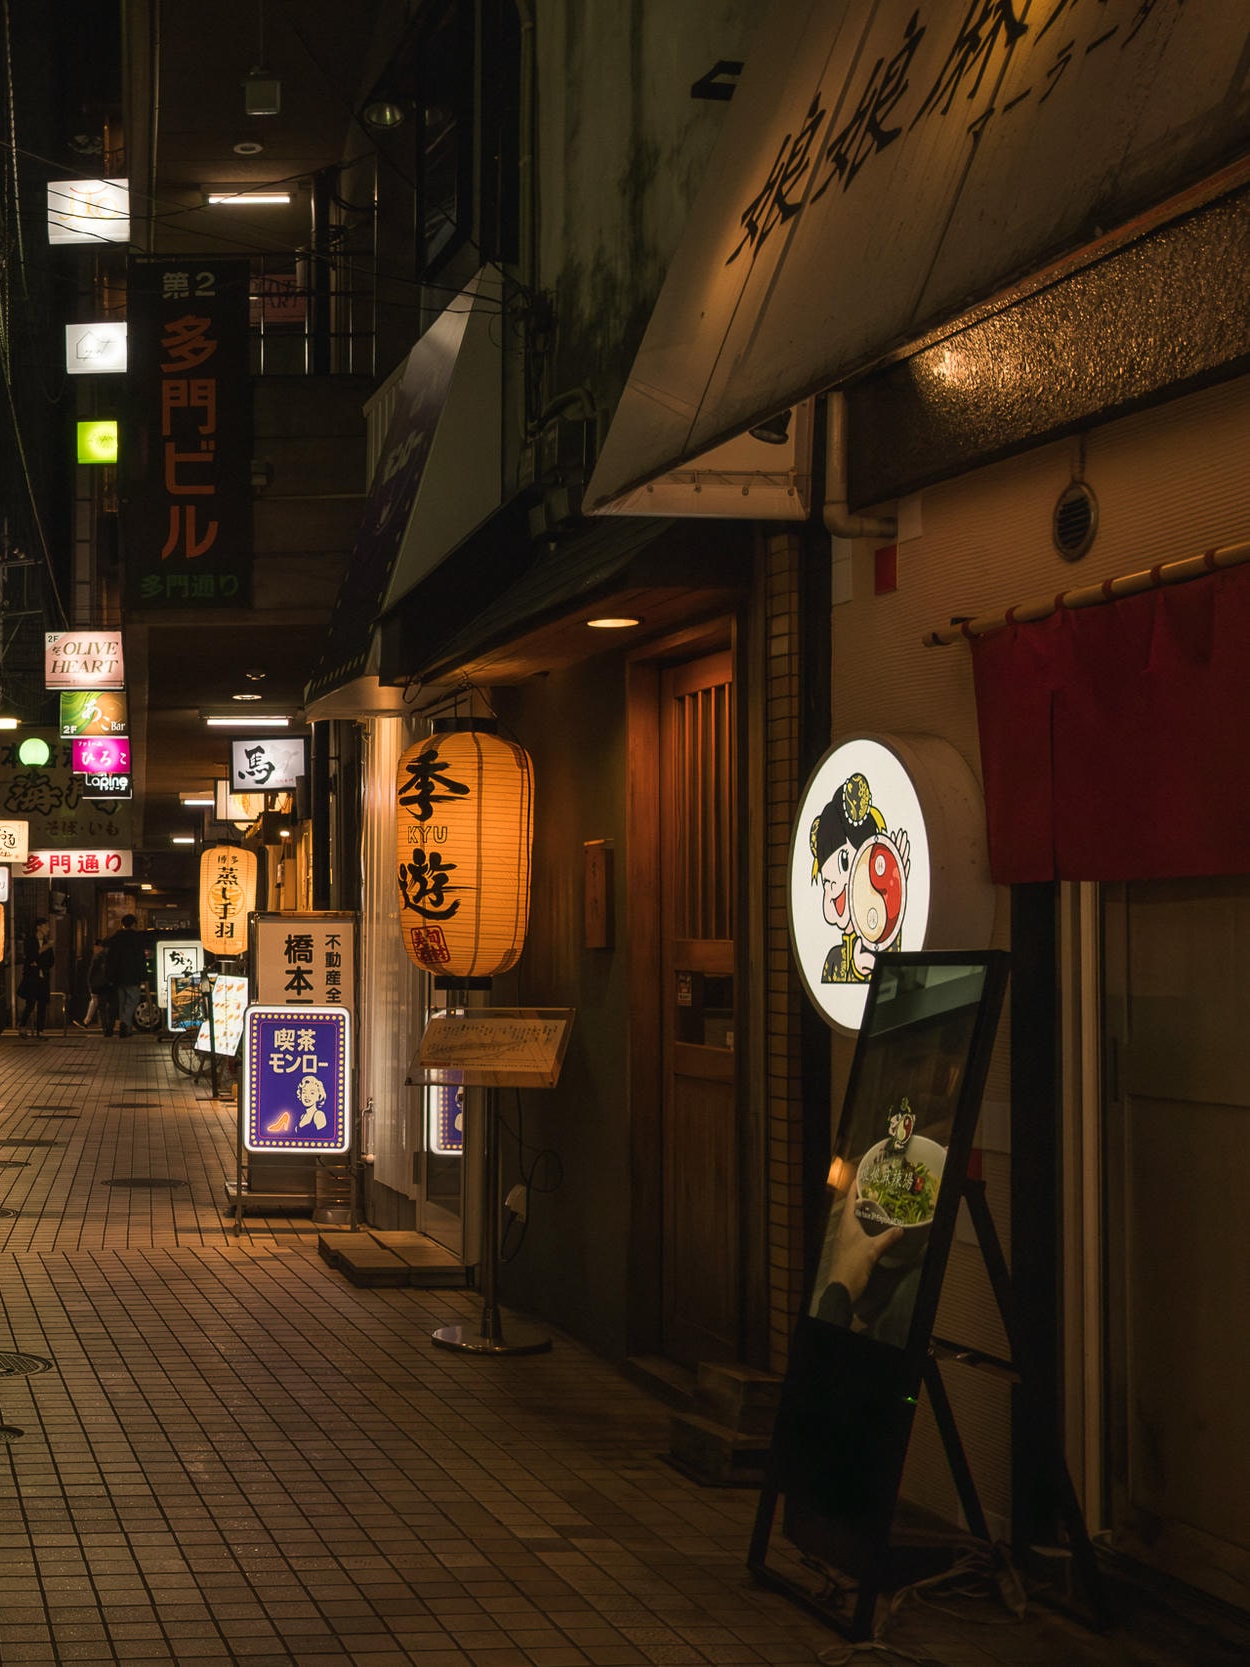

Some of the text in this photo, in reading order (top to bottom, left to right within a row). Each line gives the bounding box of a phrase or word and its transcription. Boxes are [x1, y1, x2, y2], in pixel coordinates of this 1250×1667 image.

[726, 0, 1080, 266] 娘娘麻
[162, 271, 216, 300] 第2
[160, 314, 219, 561] 多門ビル
[140, 573, 239, 600] 多門通り
[47, 635, 59, 643] 2F
[63, 641, 119, 656] OLIVE
[50, 659, 119, 674] HEART
[63, 725, 78, 734] 2F
[111, 720, 126, 732] Bar
[81, 750, 127, 767] ひろこ
[237, 745, 275, 785] 馬
[398, 750, 471, 821] 季
[406, 825, 448, 844] KYU
[22, 854, 122, 875] 多門通り
[216, 855, 238, 865] 博多
[398, 847, 477, 920] 遊
[214, 867, 239, 939] 蒸し手羽
[325, 934, 342, 1004] 不動産全
[273, 1028, 317, 1052] 喫茶
[268, 1053, 329, 1074] モンロー
